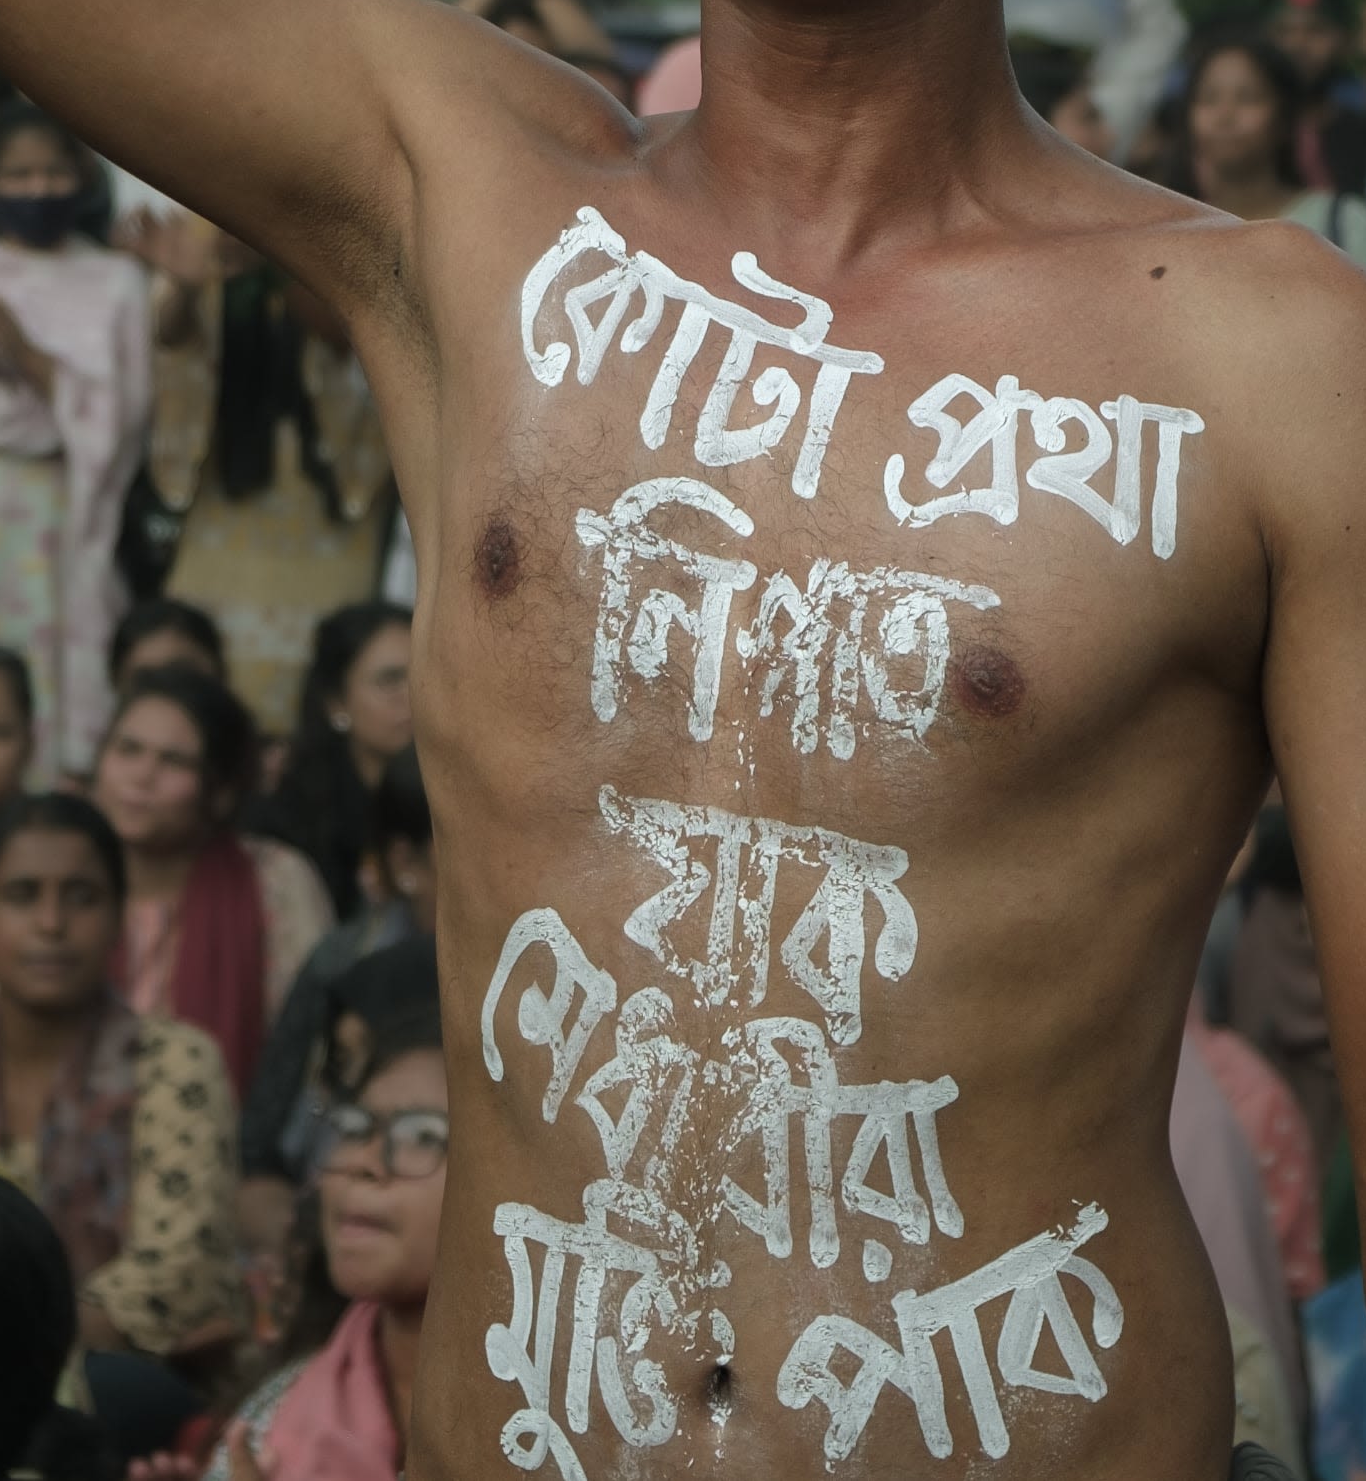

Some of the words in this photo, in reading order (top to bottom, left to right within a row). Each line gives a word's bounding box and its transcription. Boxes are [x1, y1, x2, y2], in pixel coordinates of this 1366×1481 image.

[521, 205, 885, 499] কোটা
[884, 373, 1206, 560] প্রথা
[575, 476, 1002, 761] নিপাত
[598, 784, 919, 1046] যাক
[777, 1199, 1125, 1460] পাক
